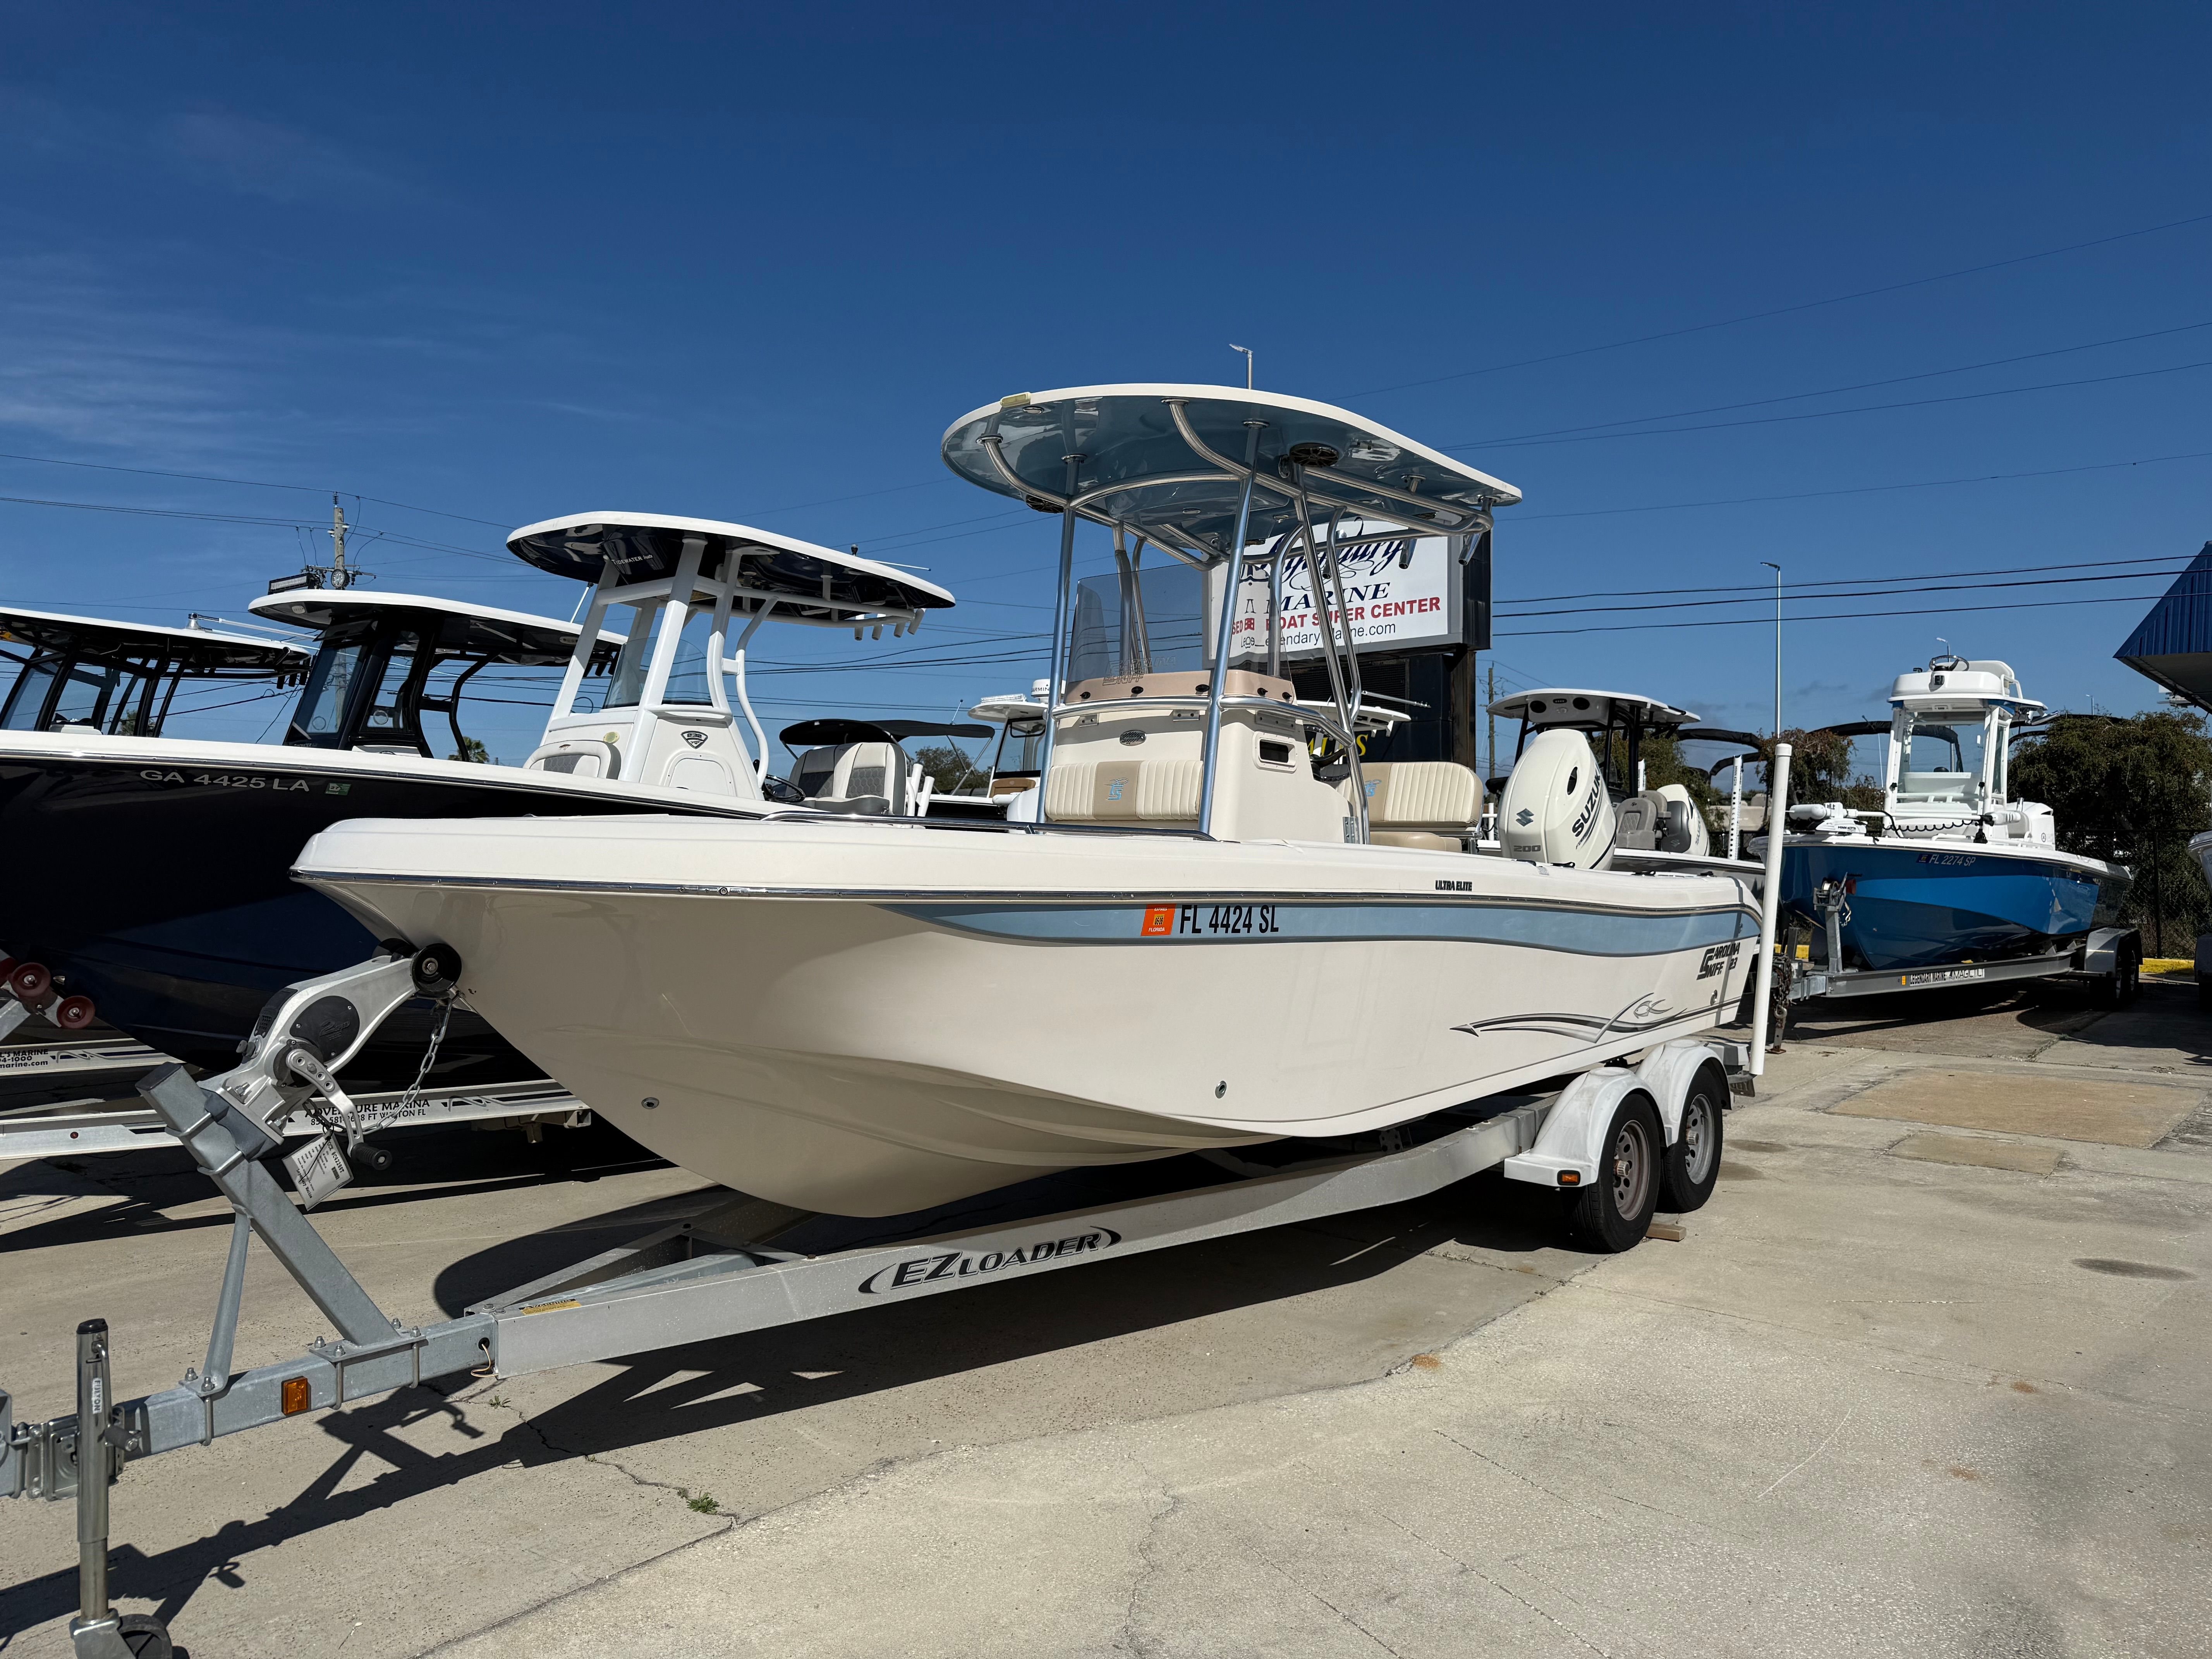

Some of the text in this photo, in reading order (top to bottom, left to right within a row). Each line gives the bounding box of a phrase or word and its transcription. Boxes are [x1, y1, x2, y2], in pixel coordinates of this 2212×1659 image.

[611, 556, 643, 565] TIDEWATER
[1370, 597, 1441, 618] CENTER
[140, 770, 309, 792] GA 4425 LA
[1929, 854, 1939, 864] FL
[1941, 855, 1965, 866] 2274
[1964, 857, 1976, 866] SP
[1435, 880, 1472, 892] ULTRA ELITE
[1180, 905, 1279, 934] FL 4424 SL
[13, 1049, 48, 1057] MARINE
